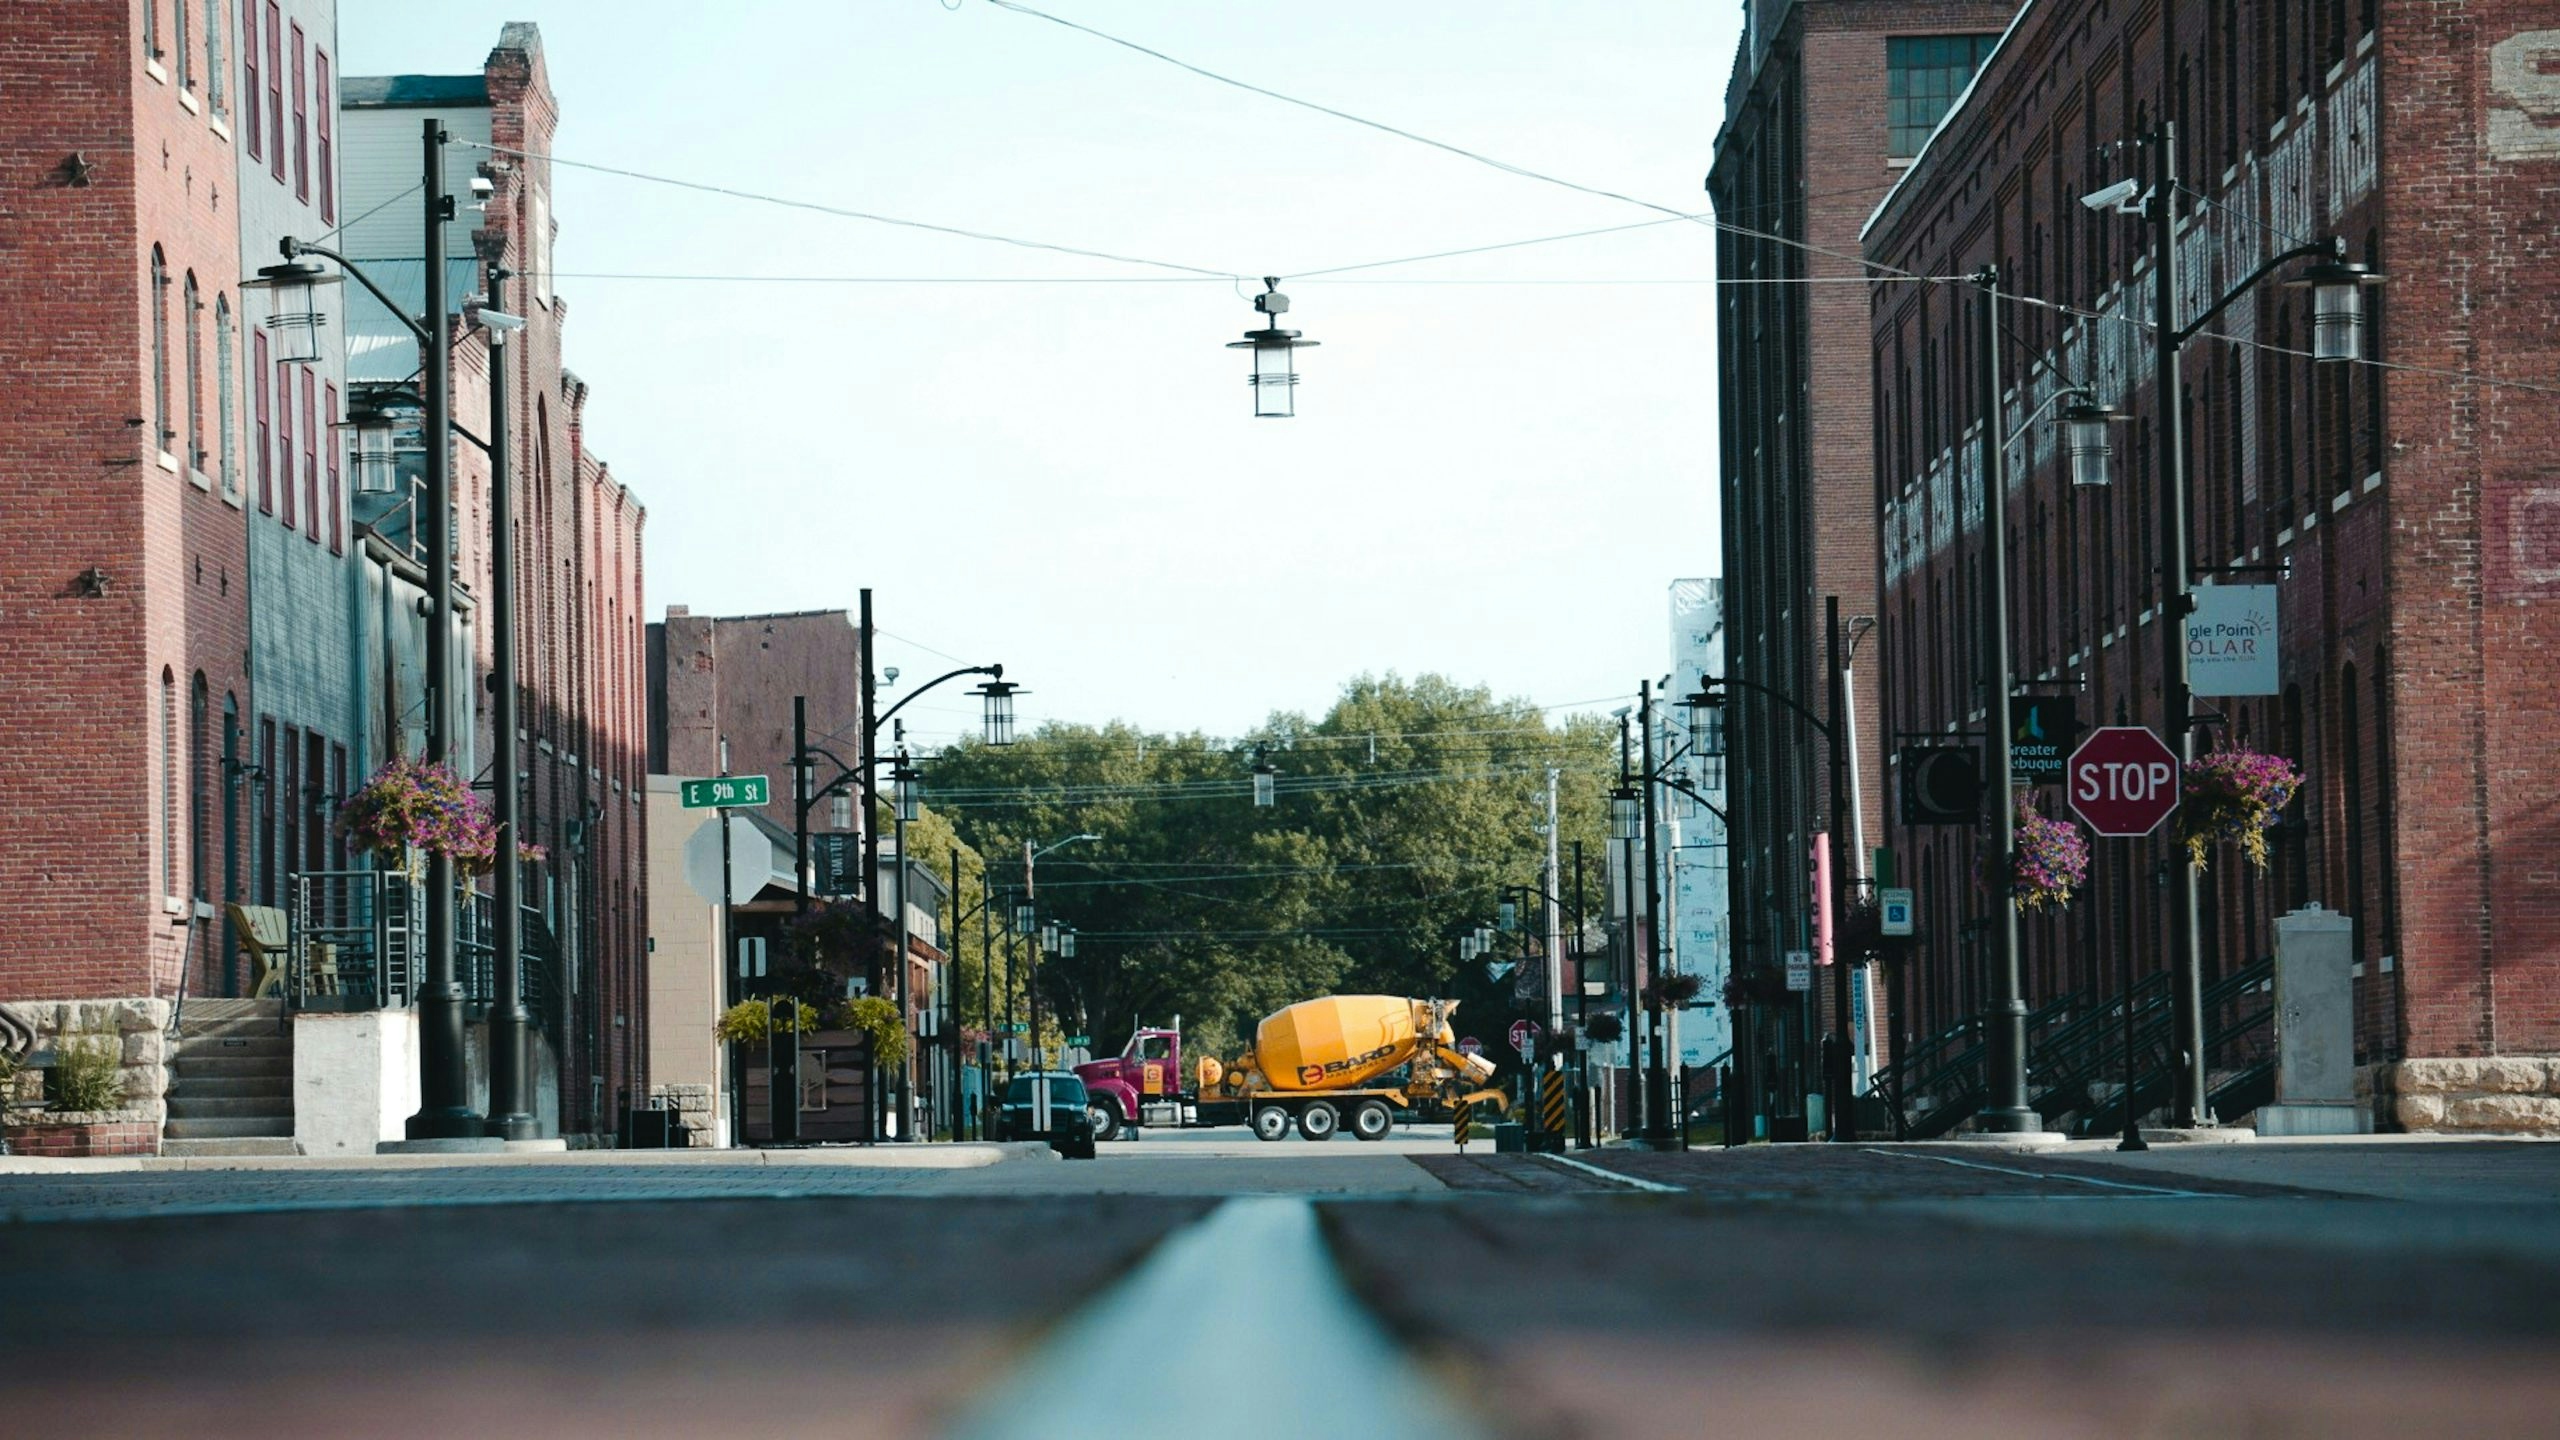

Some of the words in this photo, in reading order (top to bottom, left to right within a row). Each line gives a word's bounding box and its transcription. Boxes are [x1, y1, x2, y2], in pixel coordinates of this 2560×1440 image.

[2216, 623, 2255, 637] Point
[2188, 639, 2256, 655] OLAR
[2078, 762, 2171, 801] STOP
[690, 784, 700, 804] E
[712, 782, 735, 803] 9th
[744, 783, 759, 801] St
